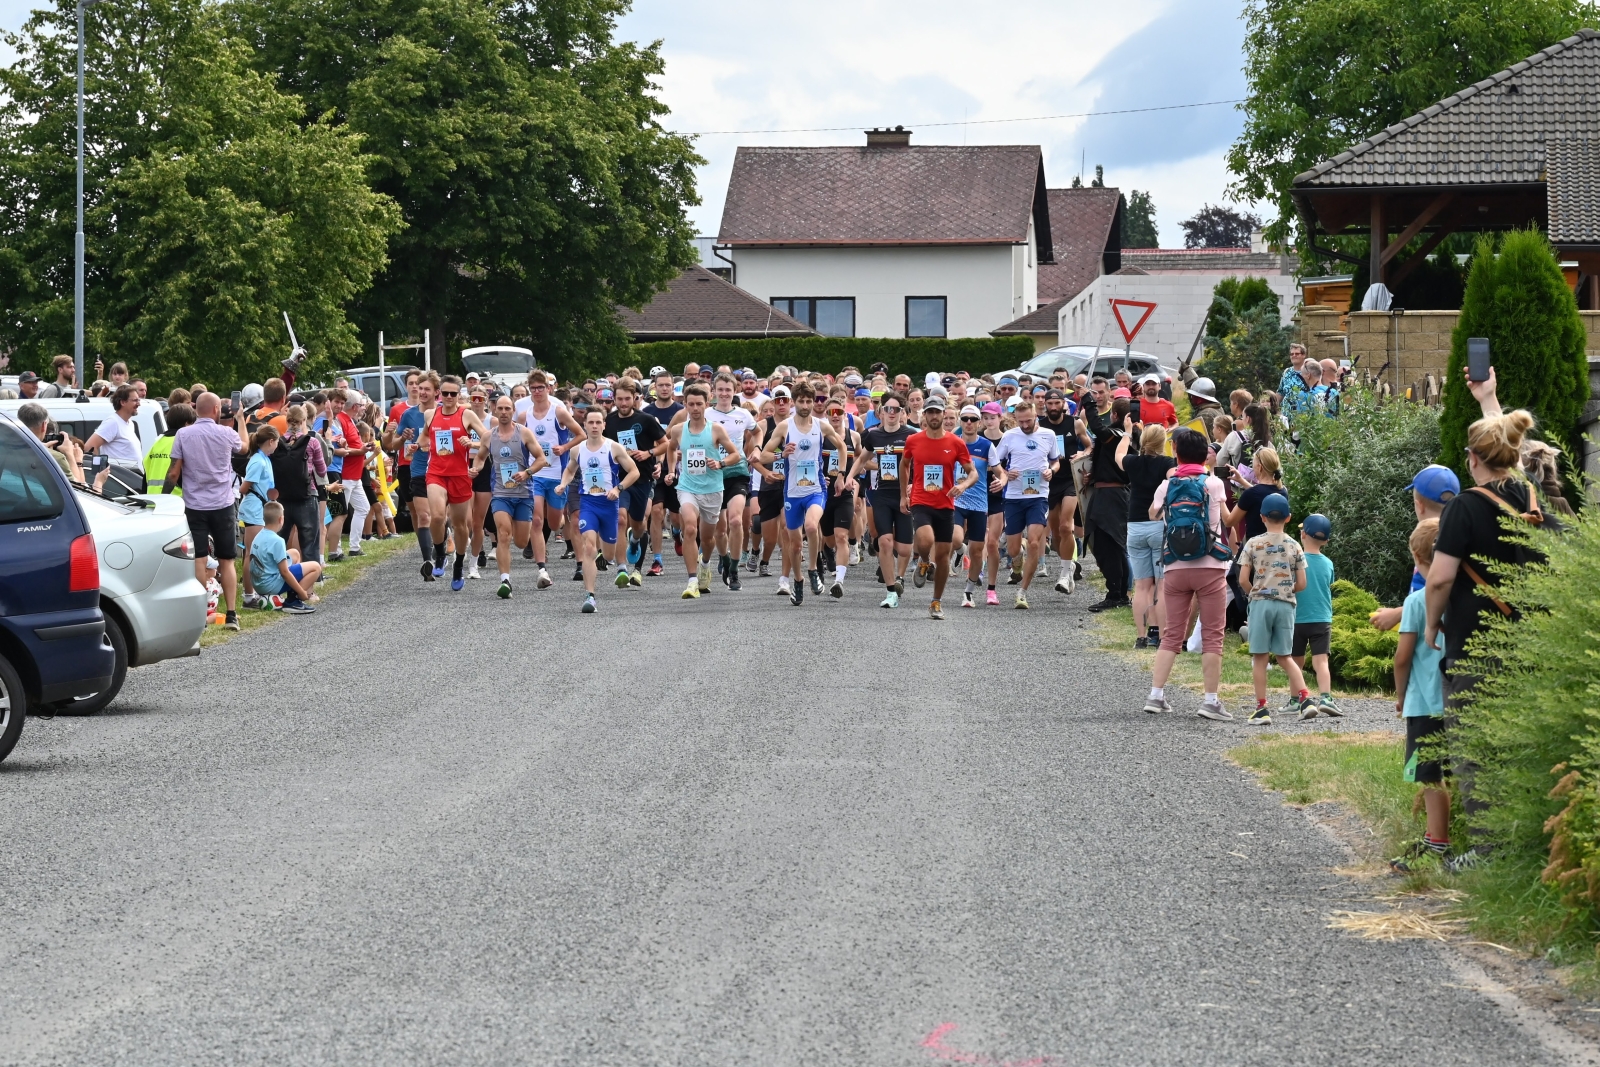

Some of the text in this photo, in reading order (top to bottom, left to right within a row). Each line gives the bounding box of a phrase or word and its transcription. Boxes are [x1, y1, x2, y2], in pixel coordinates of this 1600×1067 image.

[623, 438, 632, 446] 24
[687, 459, 706, 468] 509
[17, 524, 52, 533] FAMILY
